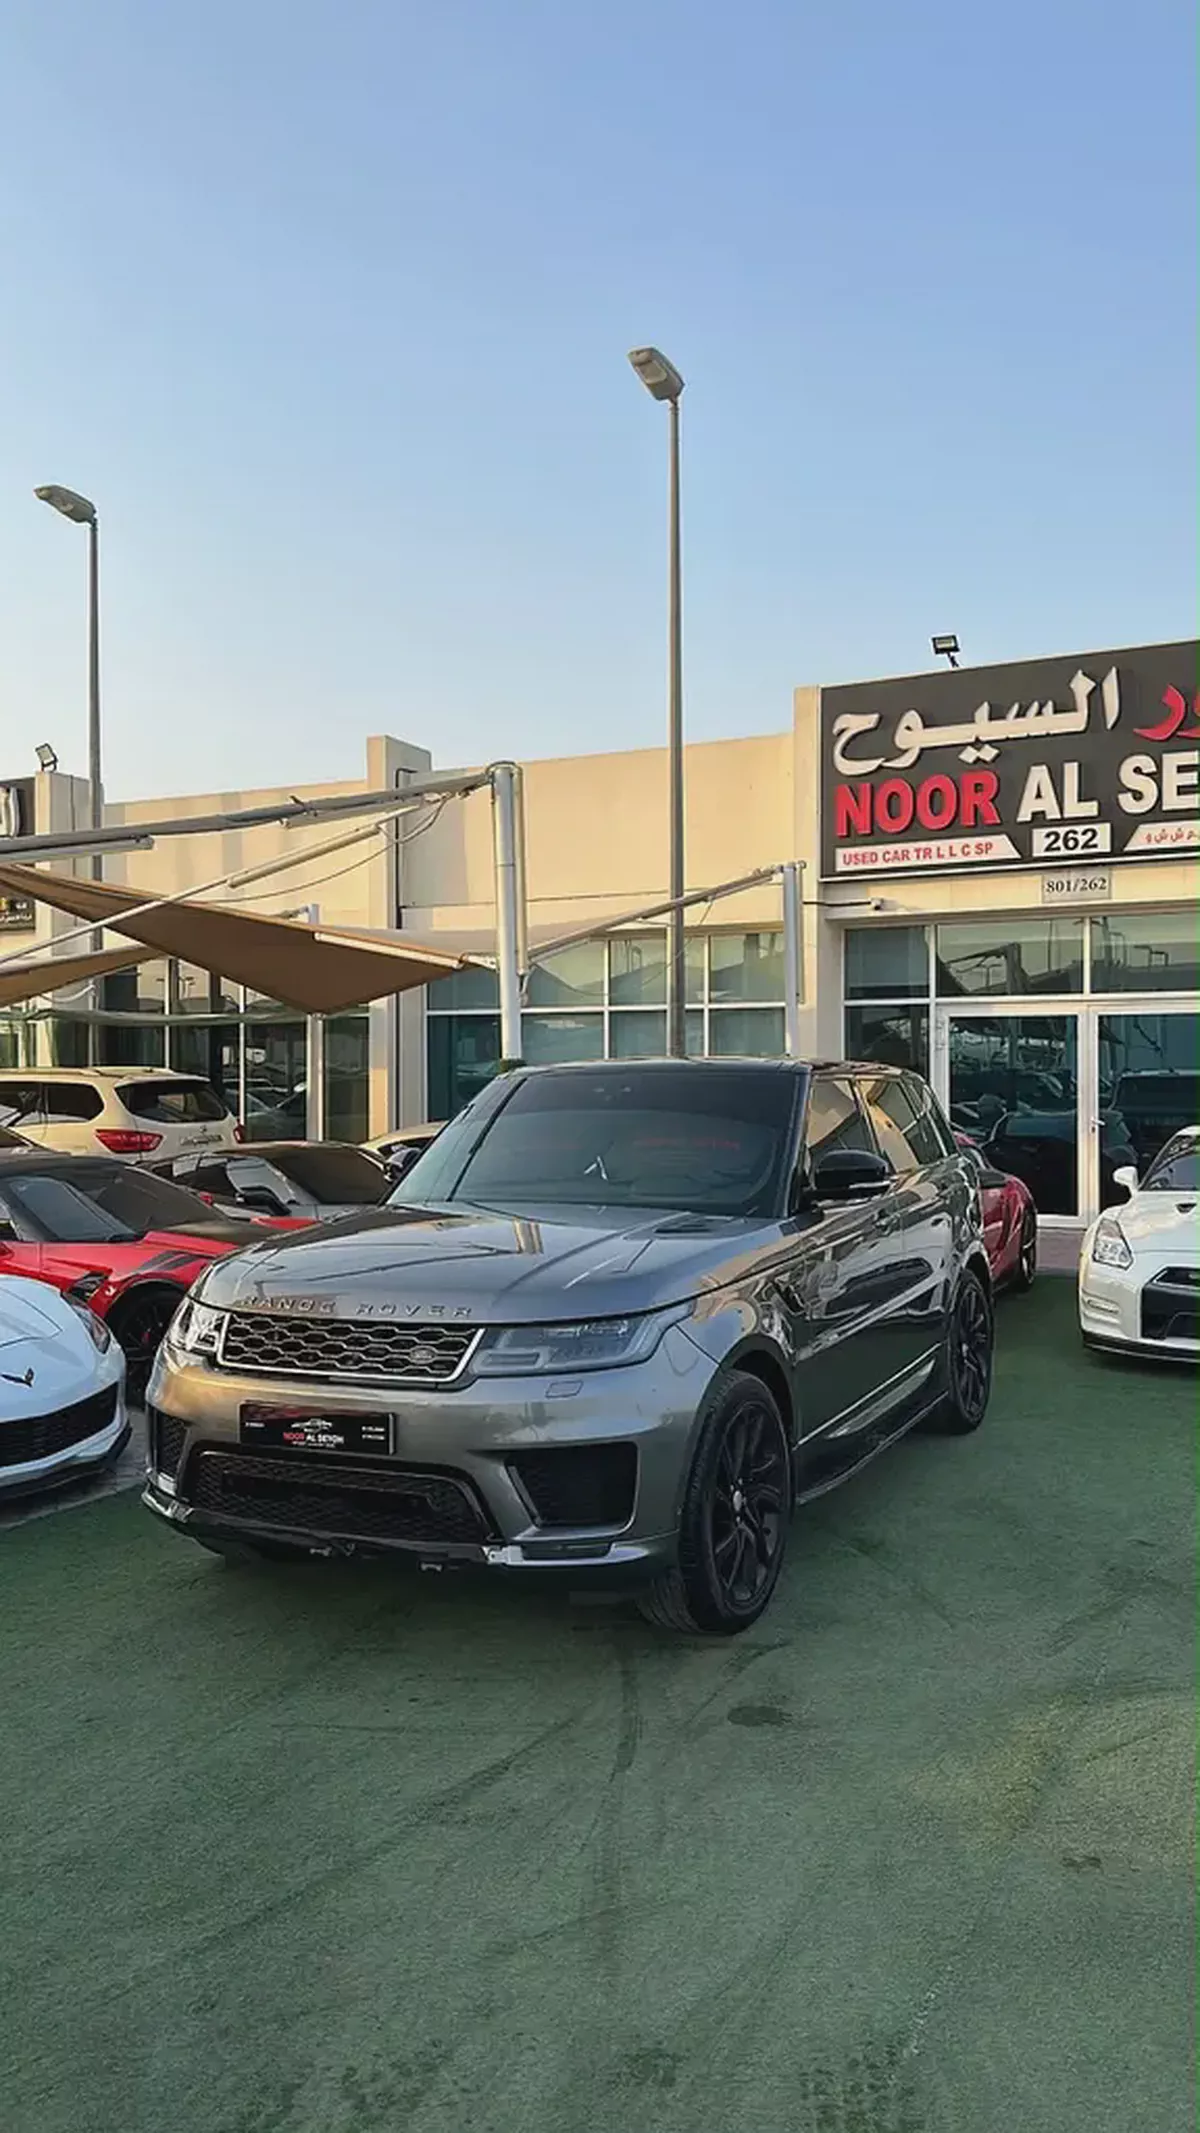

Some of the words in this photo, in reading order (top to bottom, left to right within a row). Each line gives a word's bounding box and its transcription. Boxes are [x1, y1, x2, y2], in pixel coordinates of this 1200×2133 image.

[833, 666, 1121, 776] السيوح
[835, 768, 1001, 837] NOOR
[1016, 761, 1098, 822] AL
[1044, 828, 1098, 852] 262
[842, 851, 878, 866] USED
[882, 849, 911, 864] CAR
[913, 847, 933, 860] TR
[936, 846, 945, 859] L
[949, 845, 957, 858] L
[961, 844, 971, 857] C
[974, 842, 994, 856] SP
[1045, 877, 1108, 893] 801/262
[241, 1296, 337, 1314] RANGE
[356, 1303, 473, 1318] ROVER
